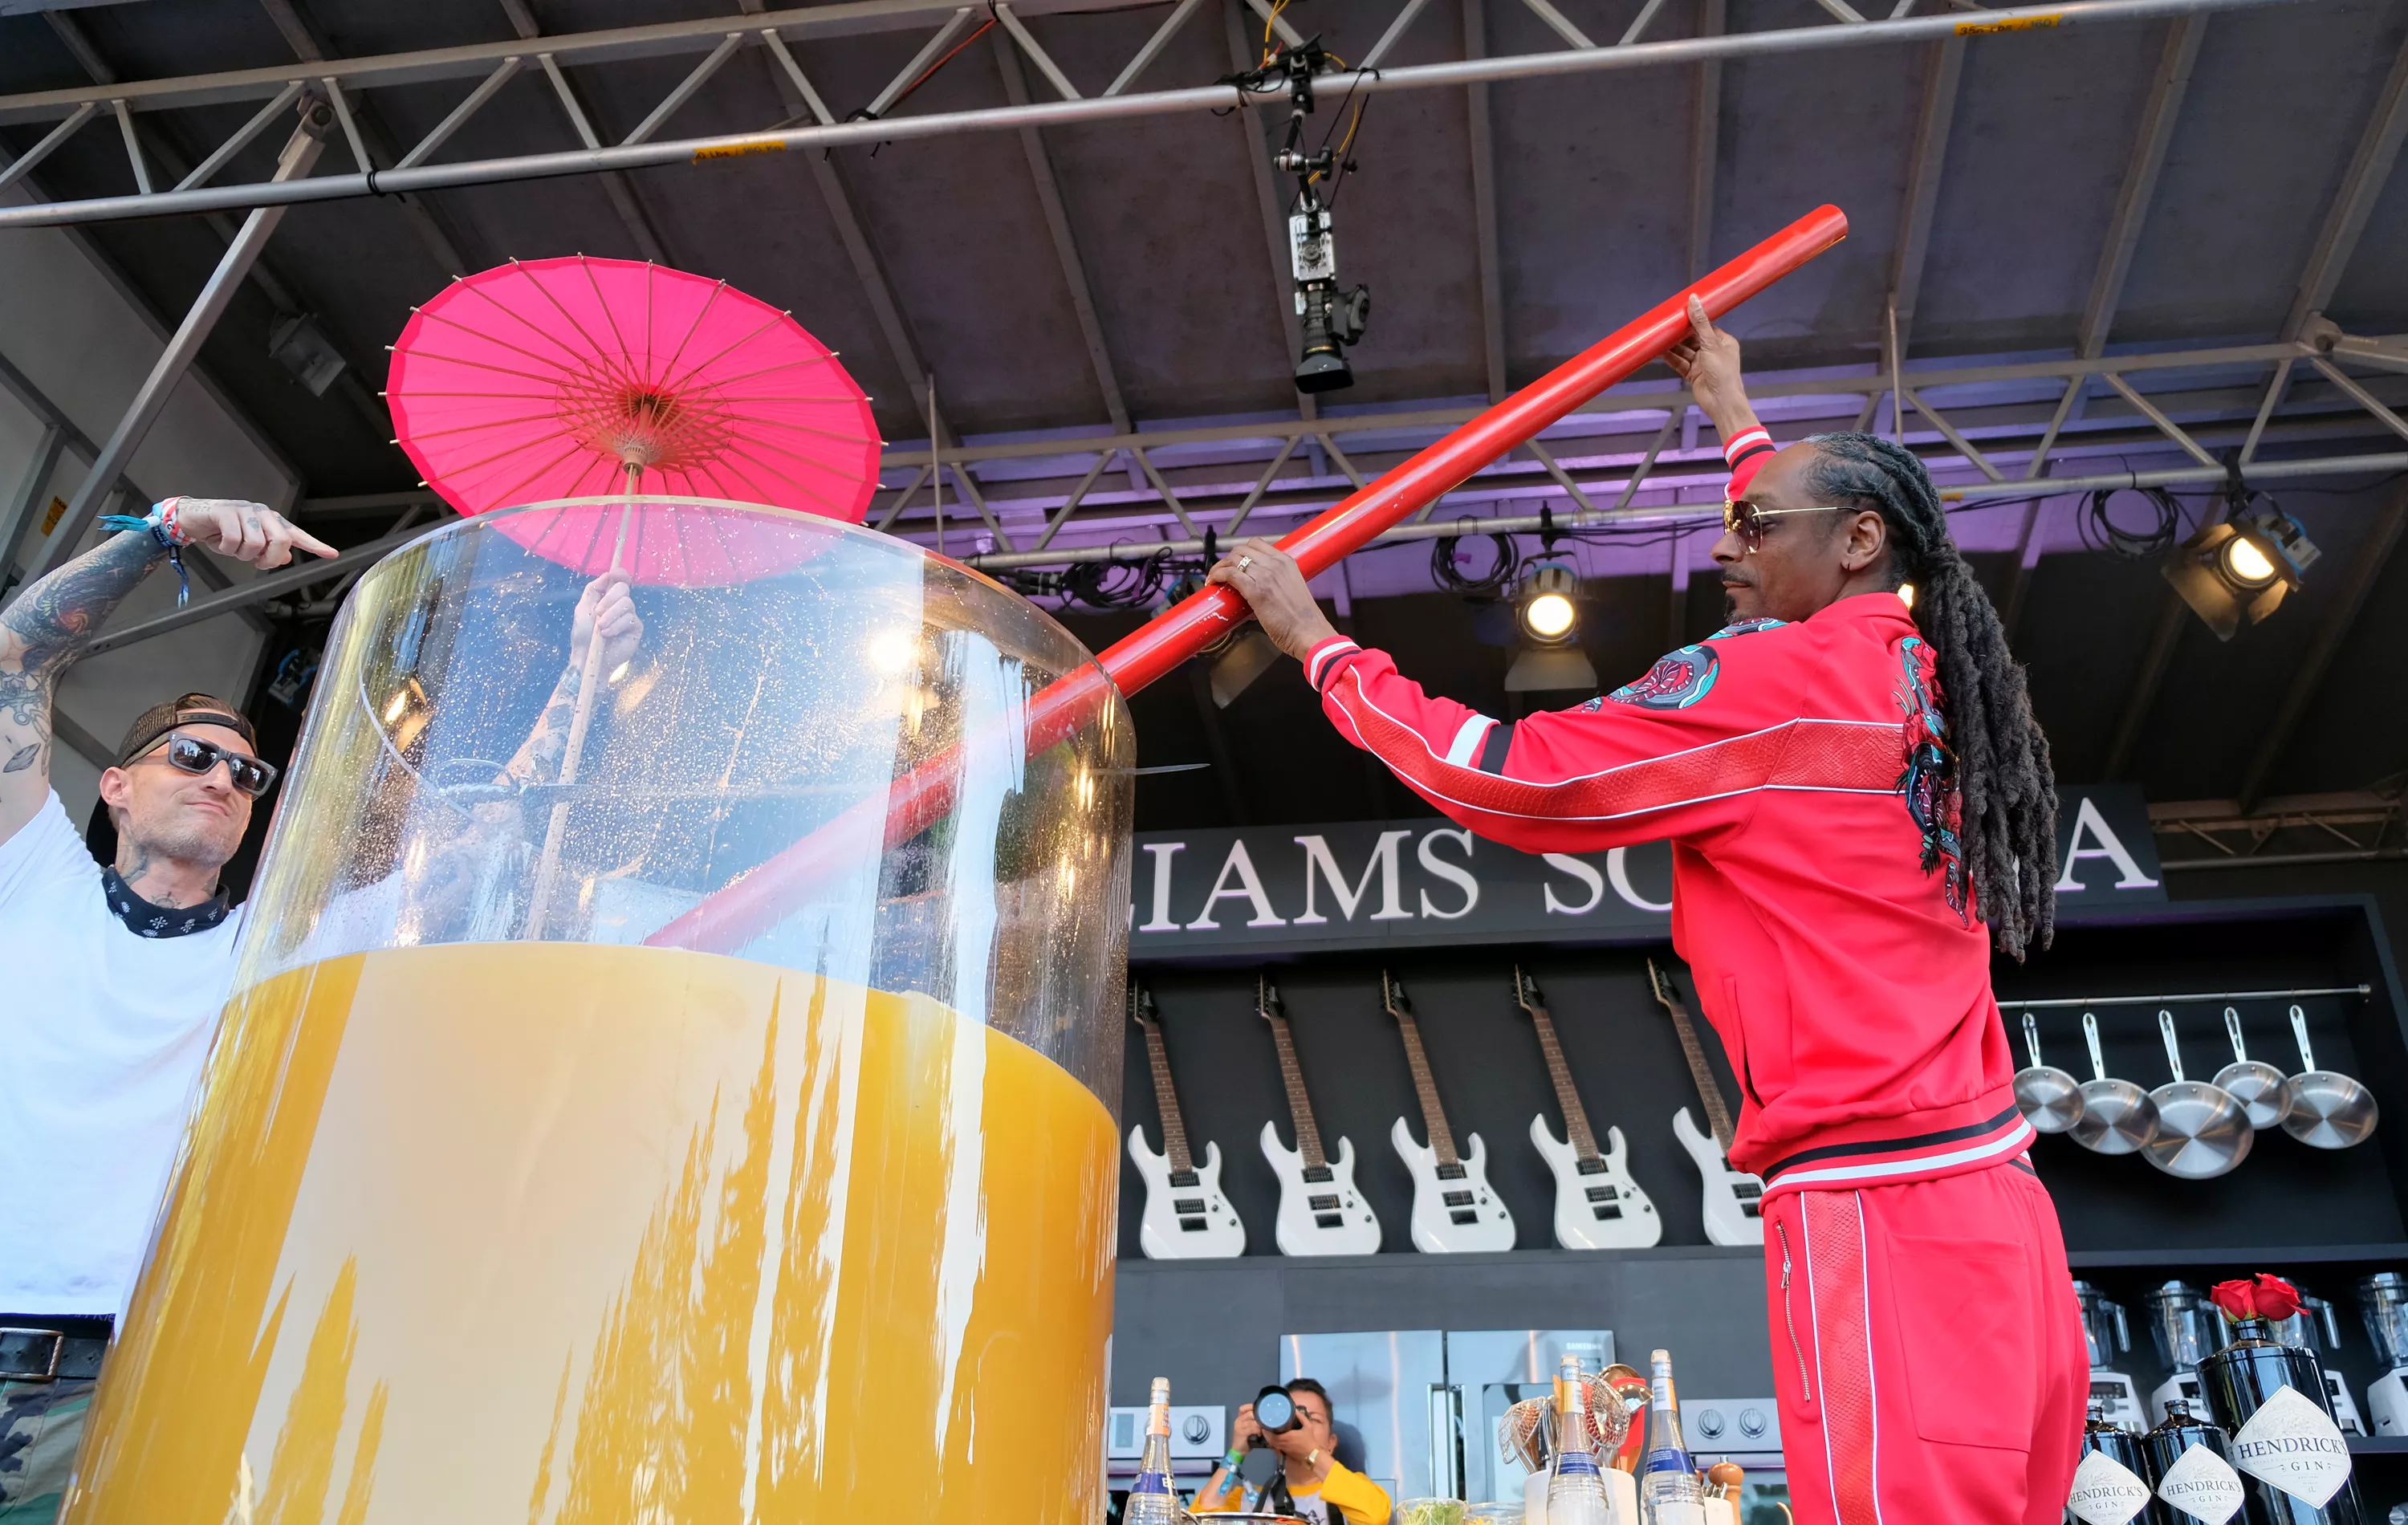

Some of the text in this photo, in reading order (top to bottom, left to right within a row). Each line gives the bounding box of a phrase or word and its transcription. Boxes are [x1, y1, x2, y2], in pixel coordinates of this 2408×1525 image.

[1129, 828, 1481, 932] IAMS
[2237, 1437, 2348, 1459] HENDRICK'S
[2290, 1461, 2325, 1471] GIN
[2069, 1486, 2144, 1504] HENDRICK'S
[2166, 1480, 2242, 1496] HENDRICK'S
[2095, 1501, 2118, 1510] GIN
[2199, 1494, 2223, 1503] GIN
